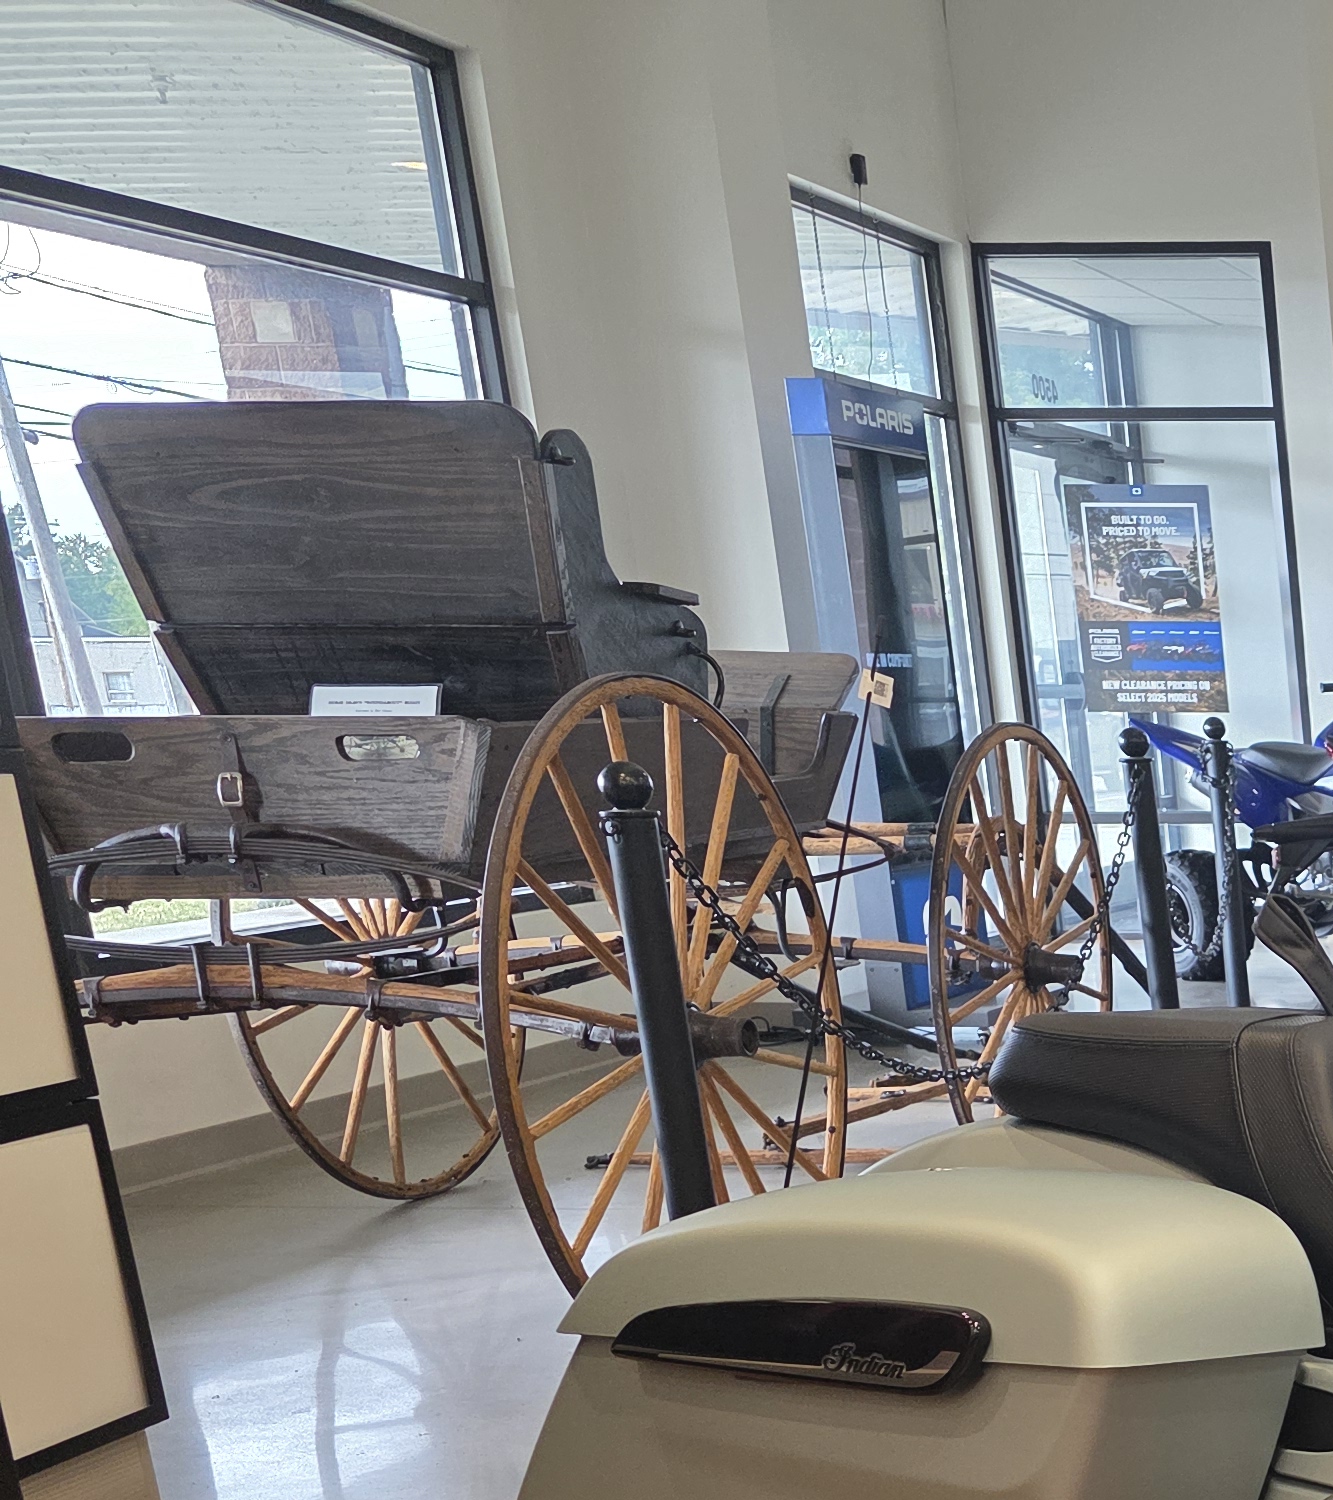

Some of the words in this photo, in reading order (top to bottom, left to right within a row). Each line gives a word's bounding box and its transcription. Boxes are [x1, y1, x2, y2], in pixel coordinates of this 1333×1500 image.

[841, 399, 914, 435] POLARIS
[1110, 515, 1138, 525] BUILT
[1140, 516, 1152, 525] TO
[1101, 526, 1137, 536] PRICED
[1138, 527, 1150, 536] TO
[1151, 527, 1181, 536] MOVE.
[1121, 680, 1167, 690] CLEARANCE
[1116, 692, 1146, 702] SELECT
[1167, 692, 1199, 703] MODELS
[821, 1341, 907, 1379] Indian
